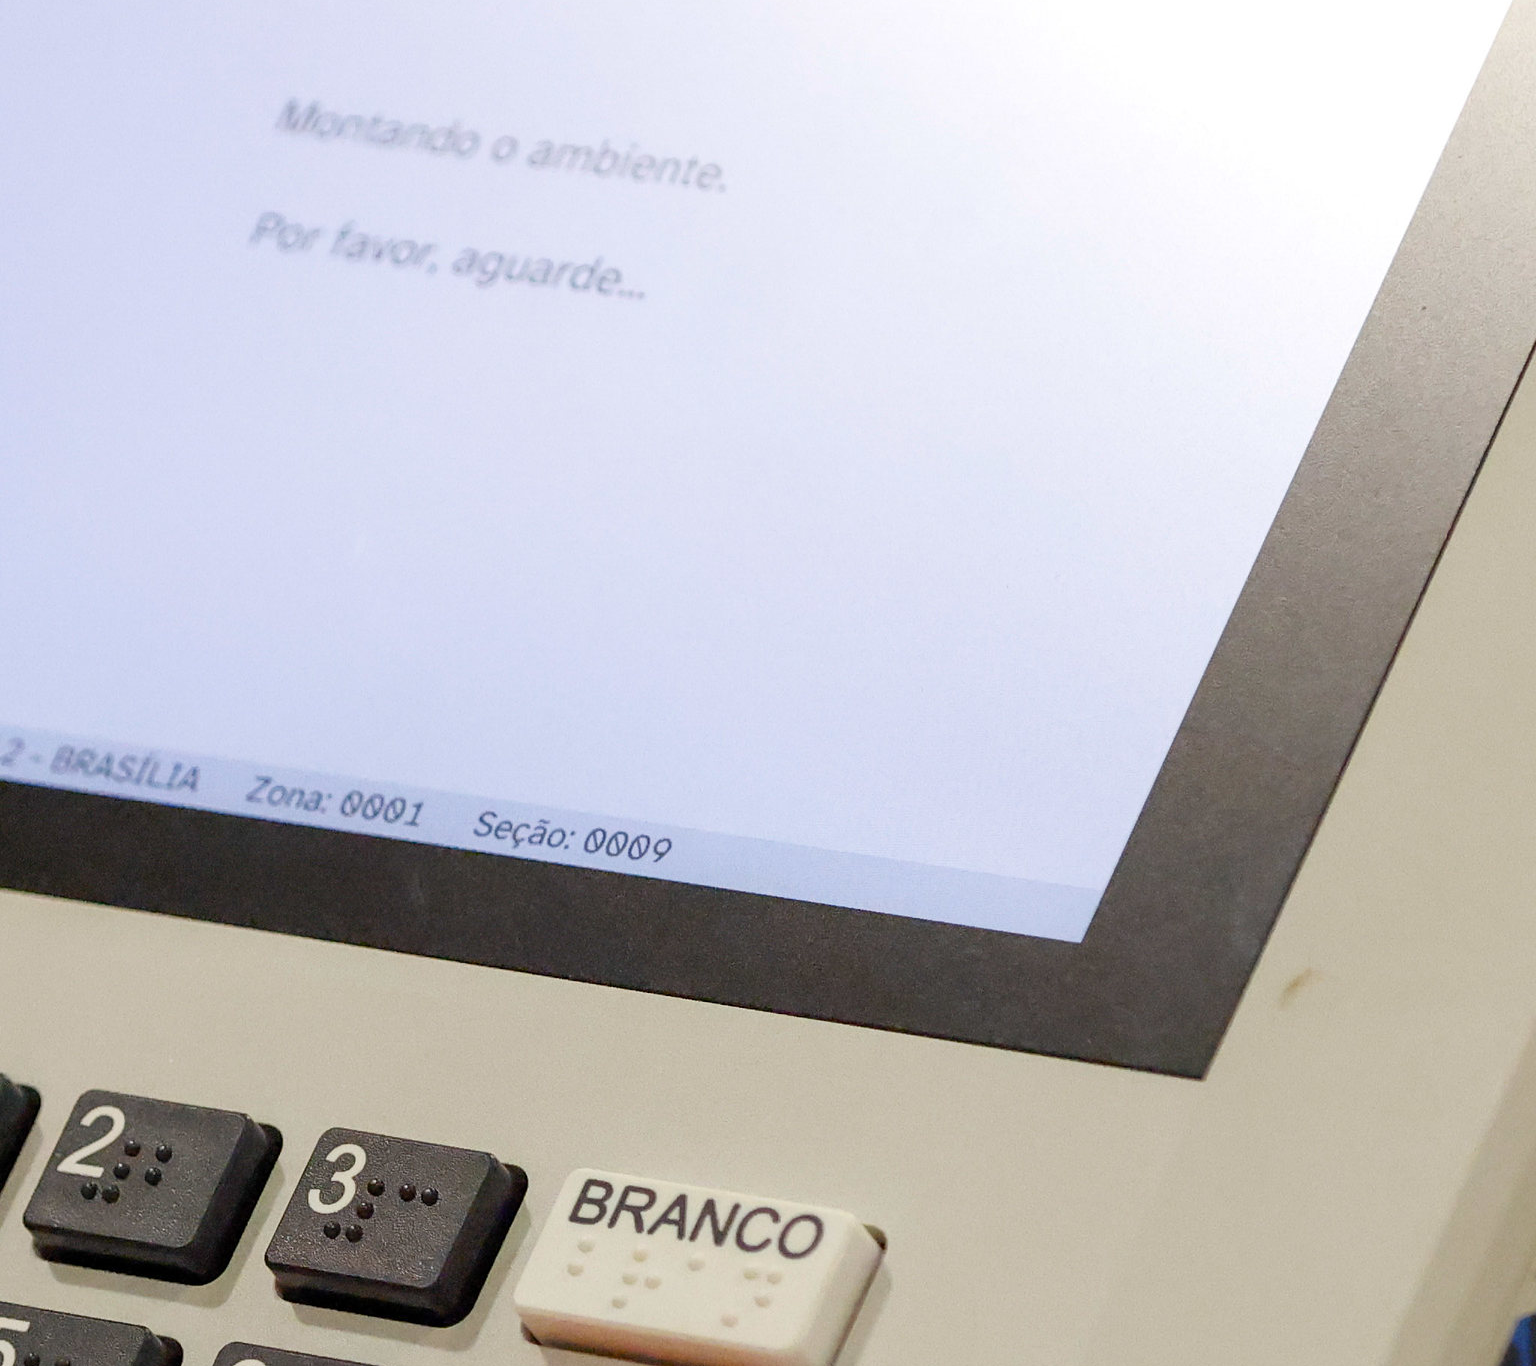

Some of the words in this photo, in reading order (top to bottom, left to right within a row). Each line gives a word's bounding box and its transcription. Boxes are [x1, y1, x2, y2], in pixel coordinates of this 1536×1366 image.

[275, 97, 481, 160] Montando
[491, 133, 520, 165] o
[528, 134, 727, 194] ambiente.
[248, 209, 322, 253] Por
[330, 218, 439, 276] favor,
[451, 244, 646, 300] aguarde...
[49, 743, 203, 794] BRASÍLIA
[246, 775, 332, 814] Zona:
[340, 789, 425, 828] 0001
[473, 810, 576, 851] Seção:
[583, 827, 672, 863] 0009
[56, 1105, 126, 1179] 2
[307, 1143, 368, 1214] 3
[568, 1177, 825, 1261] BRANCO
